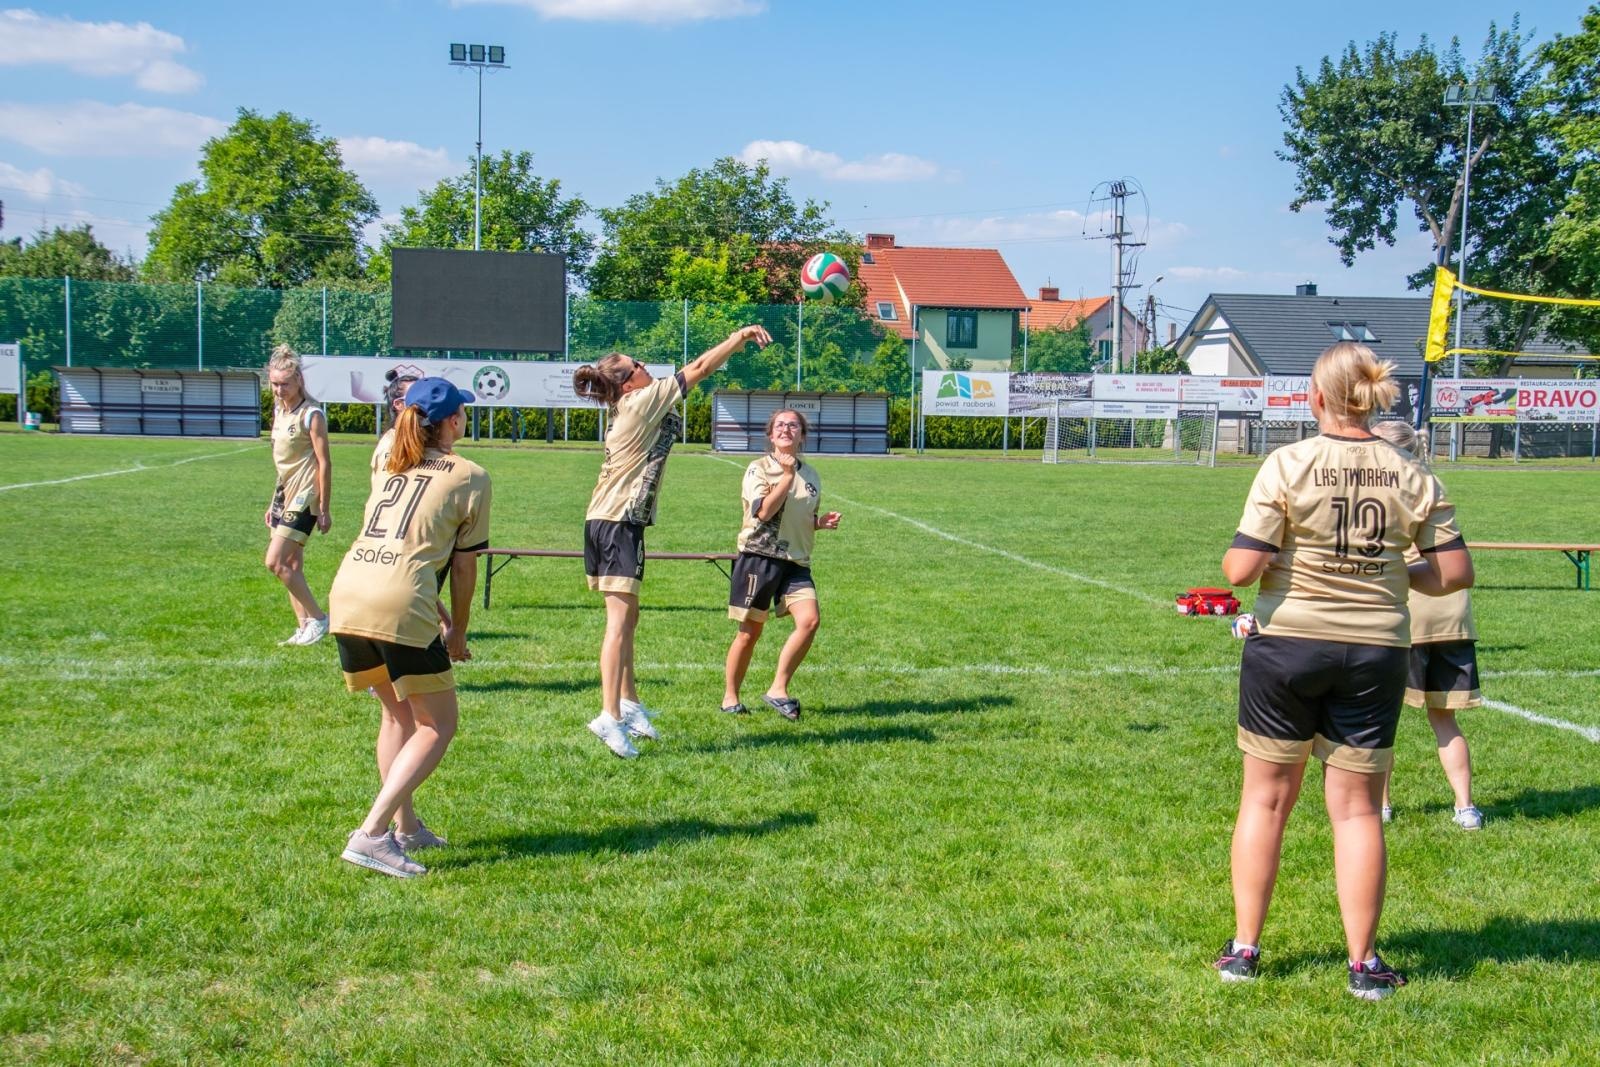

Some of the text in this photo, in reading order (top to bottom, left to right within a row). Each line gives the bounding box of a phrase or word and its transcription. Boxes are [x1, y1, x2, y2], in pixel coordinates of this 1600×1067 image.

[1267, 379, 1310, 391] HOLLAN
[963, 400, 996, 408] raciborski
[1518, 389, 1597, 408] BRAVO
[364, 473, 434, 540] 21
[353, 545, 402, 566] safer
